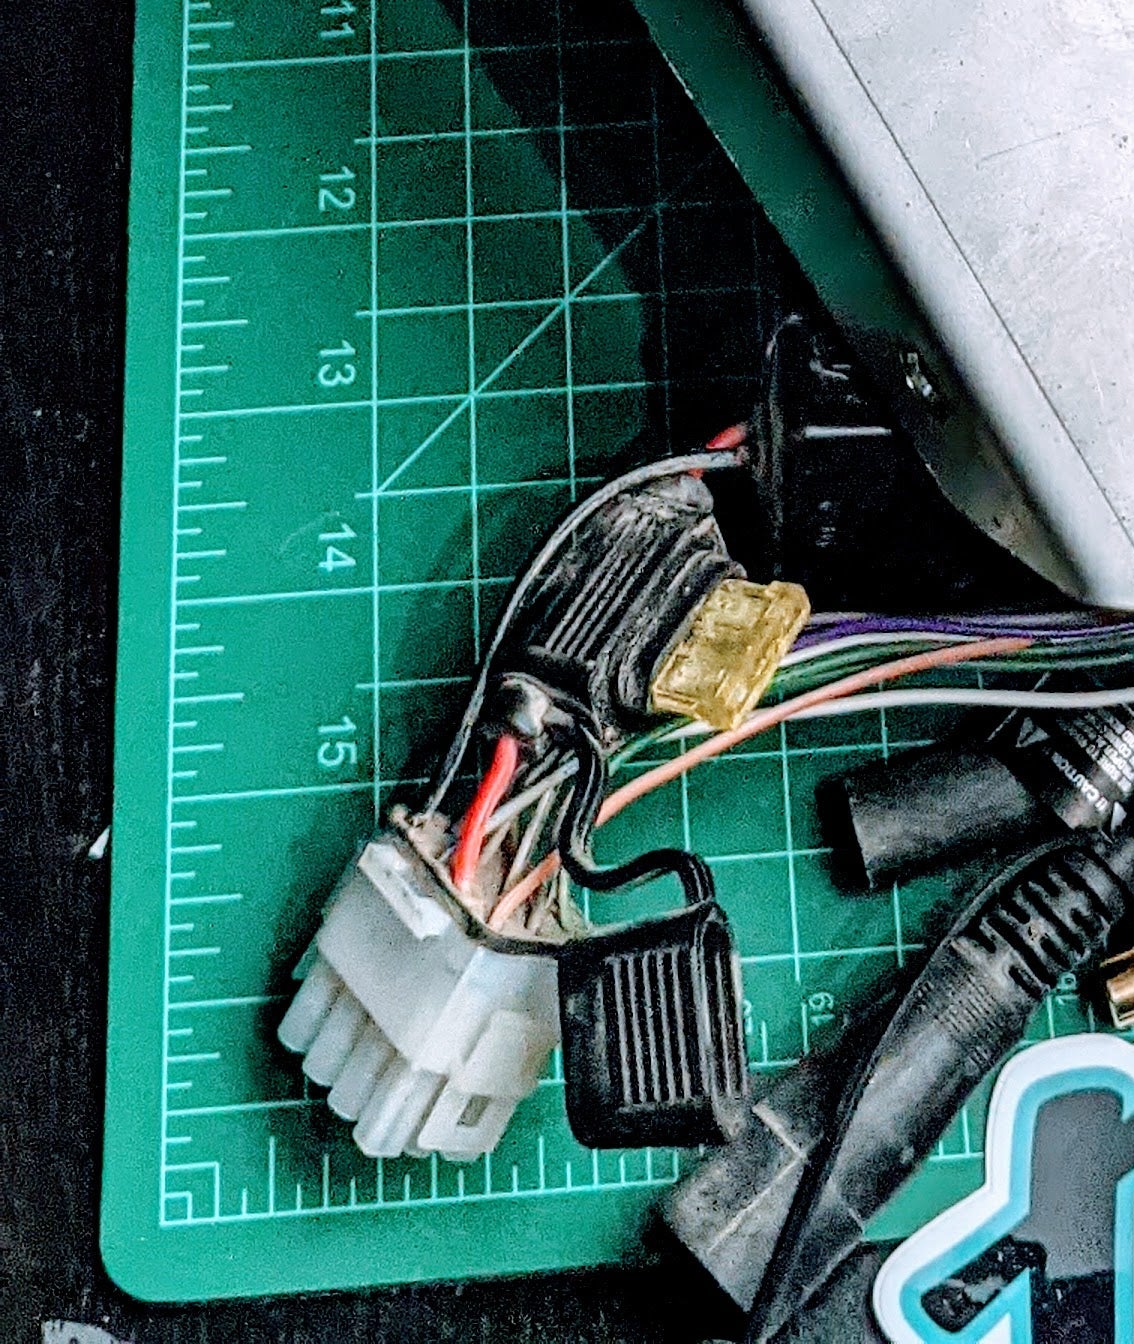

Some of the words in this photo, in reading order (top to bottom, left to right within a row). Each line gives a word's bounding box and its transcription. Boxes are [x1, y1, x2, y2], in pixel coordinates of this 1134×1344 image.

[318, 165, 357, 213] 12
[317, 339, 357, 387] 13
[317, 523, 357, 573] 14
[317, 715, 358, 769] 15
[1050, 751, 1101, 804] CAUTION
[807, 990, 836, 1025] 19
